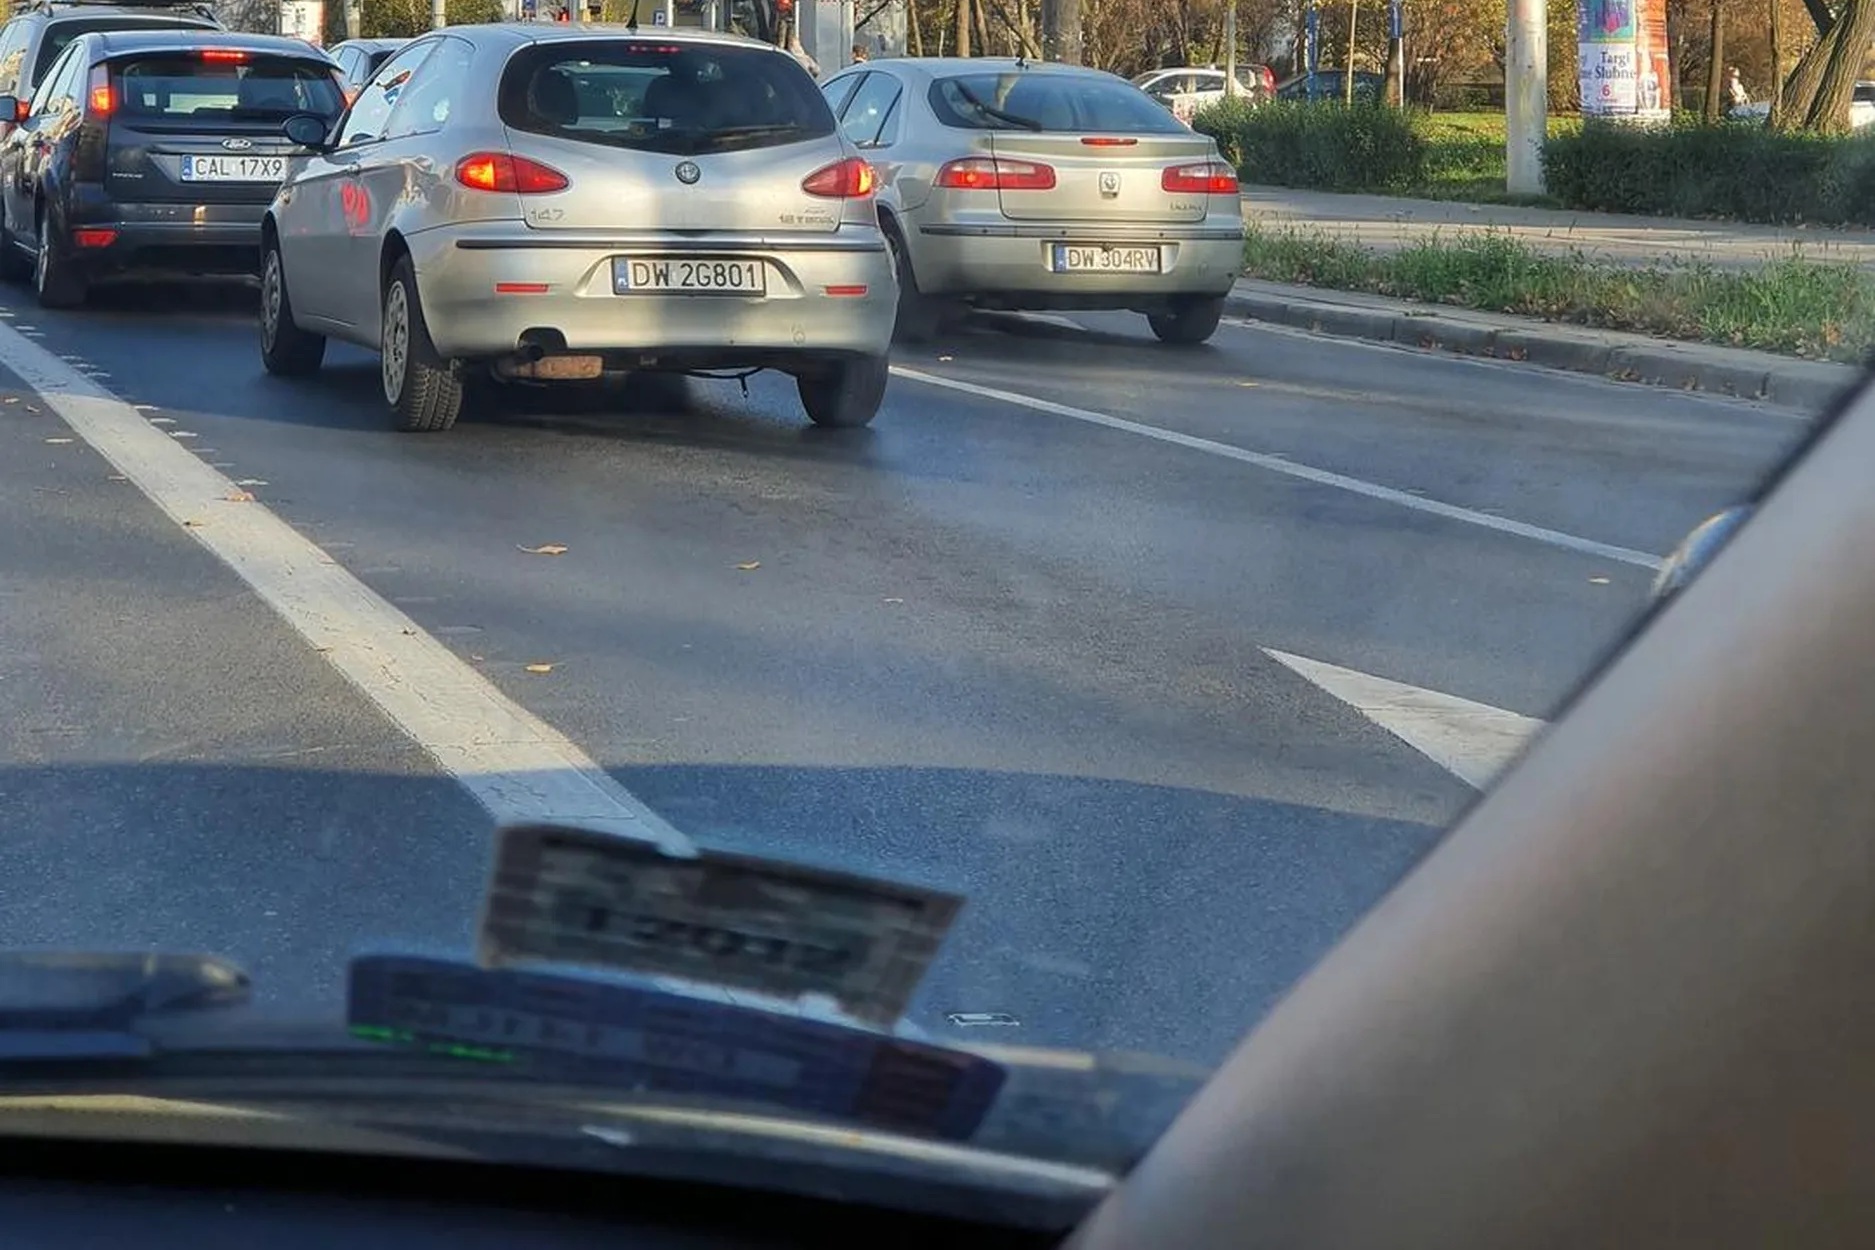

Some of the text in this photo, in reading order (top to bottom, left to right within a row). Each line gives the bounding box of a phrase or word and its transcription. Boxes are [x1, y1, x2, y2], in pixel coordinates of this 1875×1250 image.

[1600, 51, 1631, 68] Targi
[1595, 62, 1636, 79] Ślubne
[1602, 84, 1611, 97] 6
[195, 158, 282, 176] CAL 17X9
[1068, 249, 1156, 268] DW 304RV
[632, 262, 756, 288] DW 2G801
